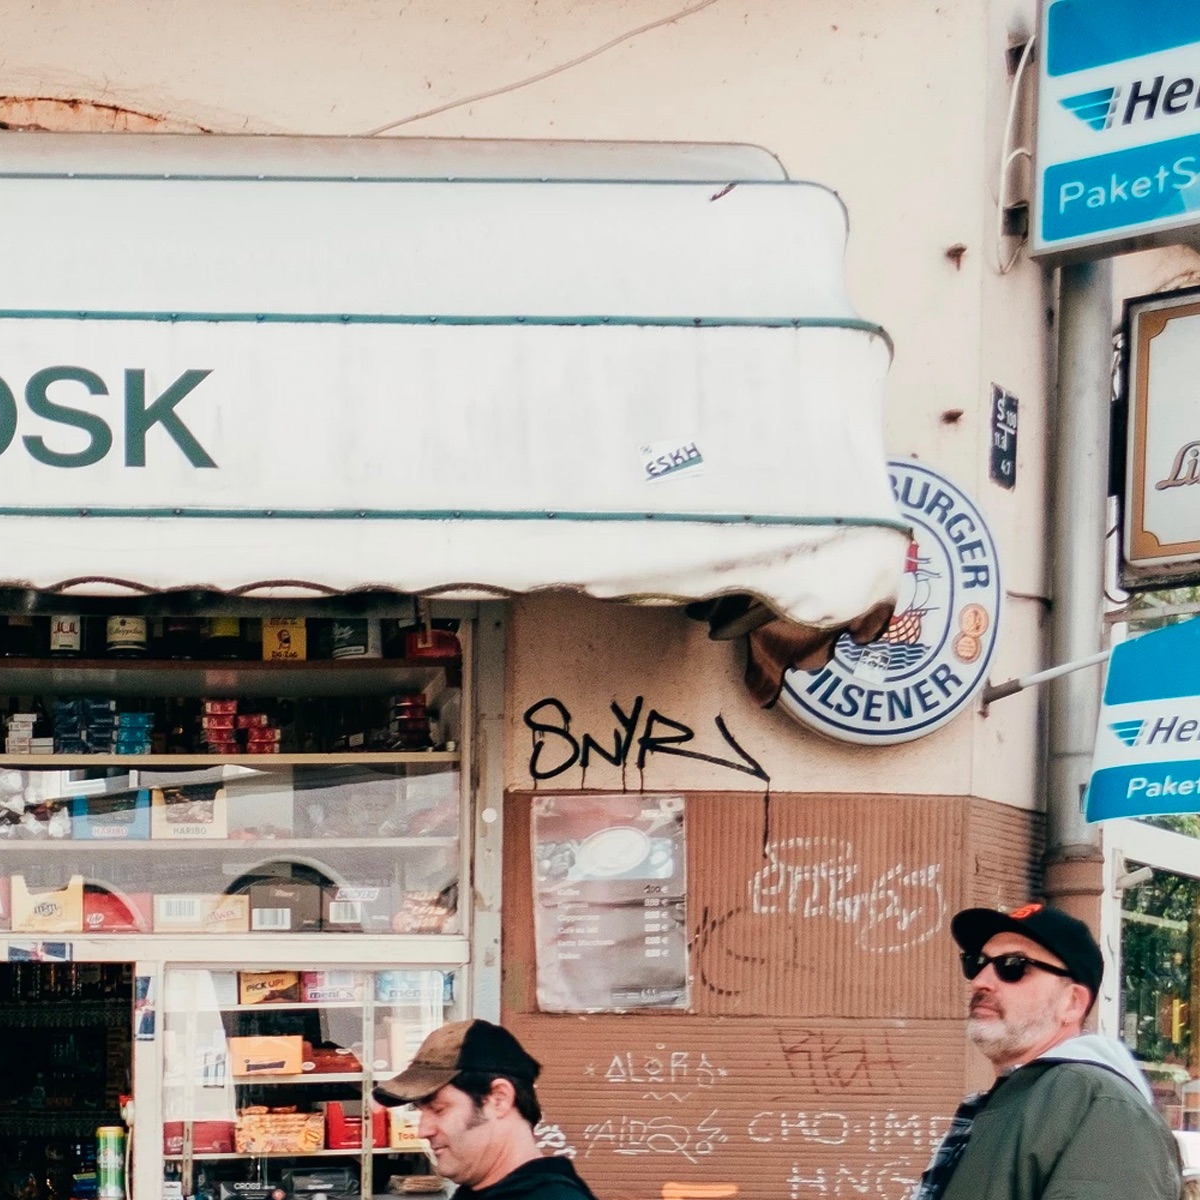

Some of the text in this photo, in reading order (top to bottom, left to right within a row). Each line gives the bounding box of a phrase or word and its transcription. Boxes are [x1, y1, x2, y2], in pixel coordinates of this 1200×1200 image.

[1122, 75, 1200, 126] He
[1059, 155, 1200, 215] PaketS
[804, 661, 964, 723] ILSENER
[1146, 714, 1200, 745] He
[173, 826, 207, 835] HARIBO
[246, 982, 267, 992] PICK
